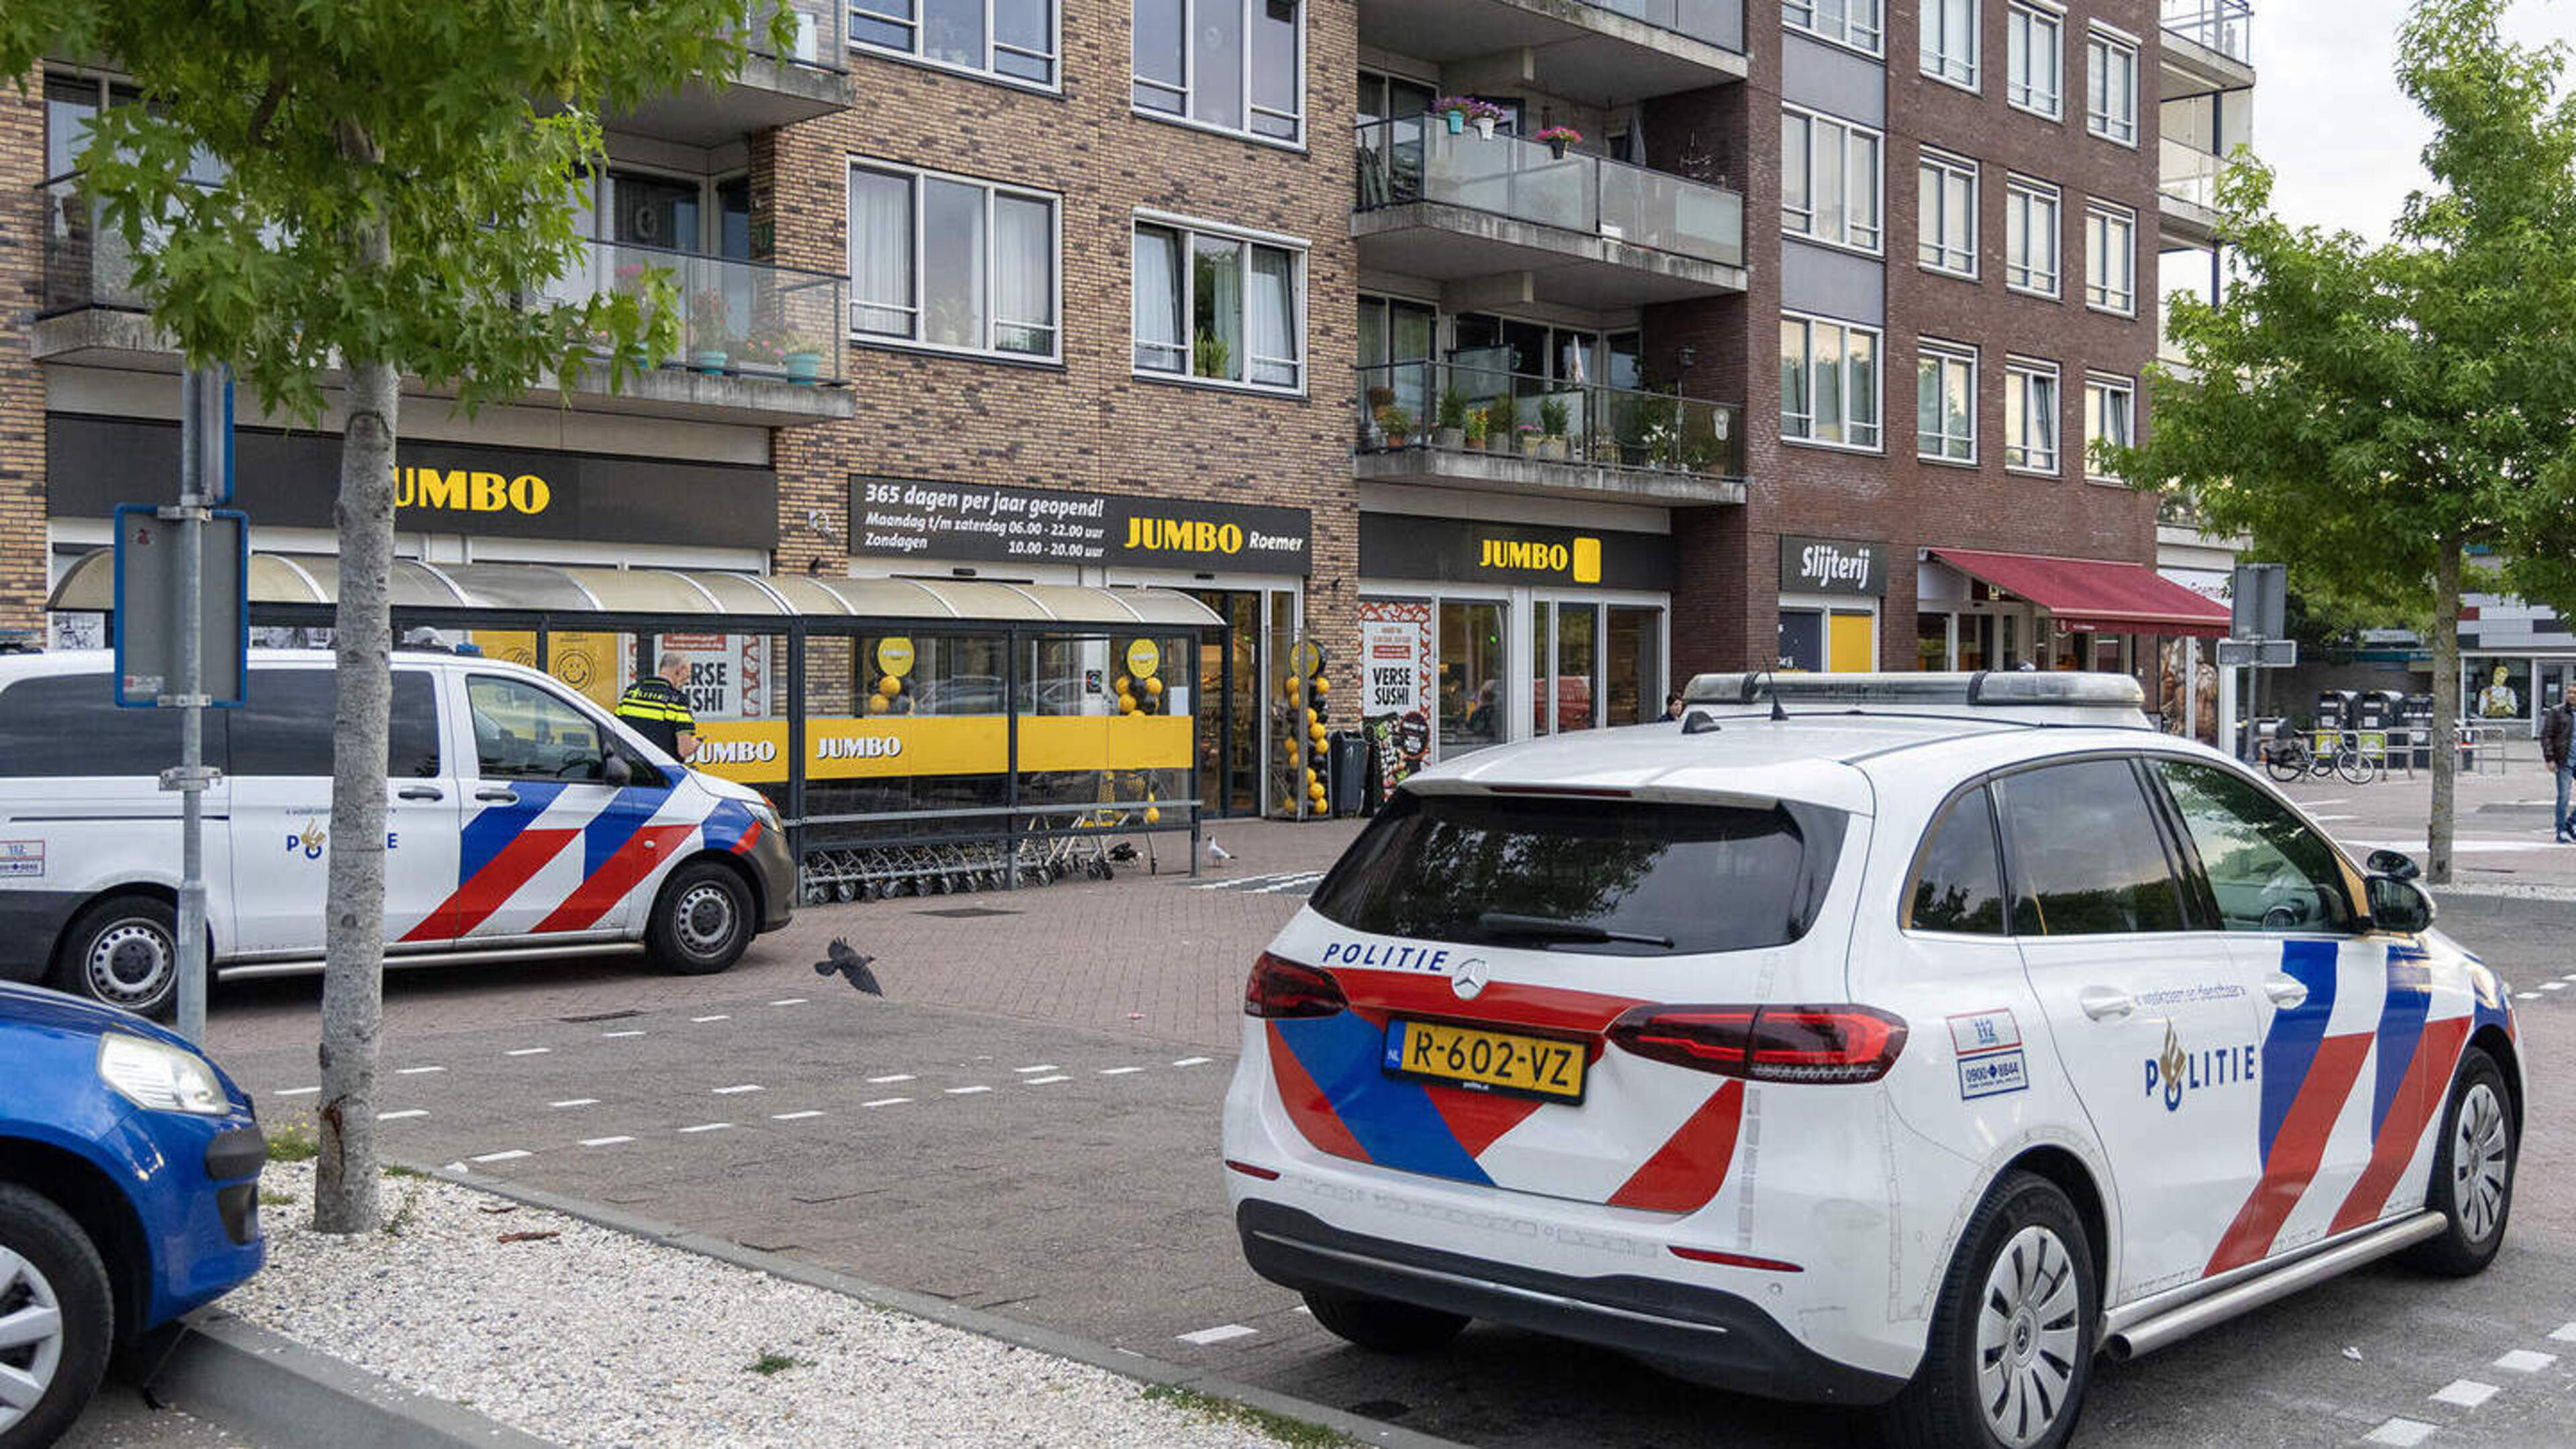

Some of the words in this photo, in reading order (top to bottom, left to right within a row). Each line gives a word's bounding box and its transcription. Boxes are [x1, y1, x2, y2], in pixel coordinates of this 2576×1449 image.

[394, 466, 550, 514] UMBO
[865, 484, 900, 503] 365
[904, 484, 958, 511] dagen
[961, 492, 990, 514] per
[990, 491, 1027, 516] jaar
[1028, 498, 1105, 520] geopend!
[865, 511, 926, 532] Maandag
[928, 515, 952, 531] t/m
[954, 518, 1007, 537] zaterdag
[1008, 521, 1042, 535] 06.00
[1050, 523, 1083, 537] 22.00
[1085, 527, 1105, 539] uur
[1124, 517, 1244, 554] JUMBO
[1248, 531, 1303, 552] Roemer
[865, 533, 928, 552] Zondagen
[1008, 540, 1042, 555] 10.00
[1050, 542, 1083, 557] 20.00
[1085, 547, 1105, 557] uur
[1479, 539, 1568, 571] JUMBO
[1801, 545, 1870, 589] Slijterij
[685, 662, 727, 686] RSE
[1373, 667, 1411, 686] VERSE
[1375, 686, 1409, 706] SUSHI
[815, 737, 902, 759] JUMBO
[1323, 943, 1450, 971] POLITIE
[1974, 1019, 1996, 1040] 112
[1387, 1049, 1400, 1061] NL
[1413, 1030, 1573, 1087] R-602-VZ
[2145, 1044, 2255, 1112] POLITIE
